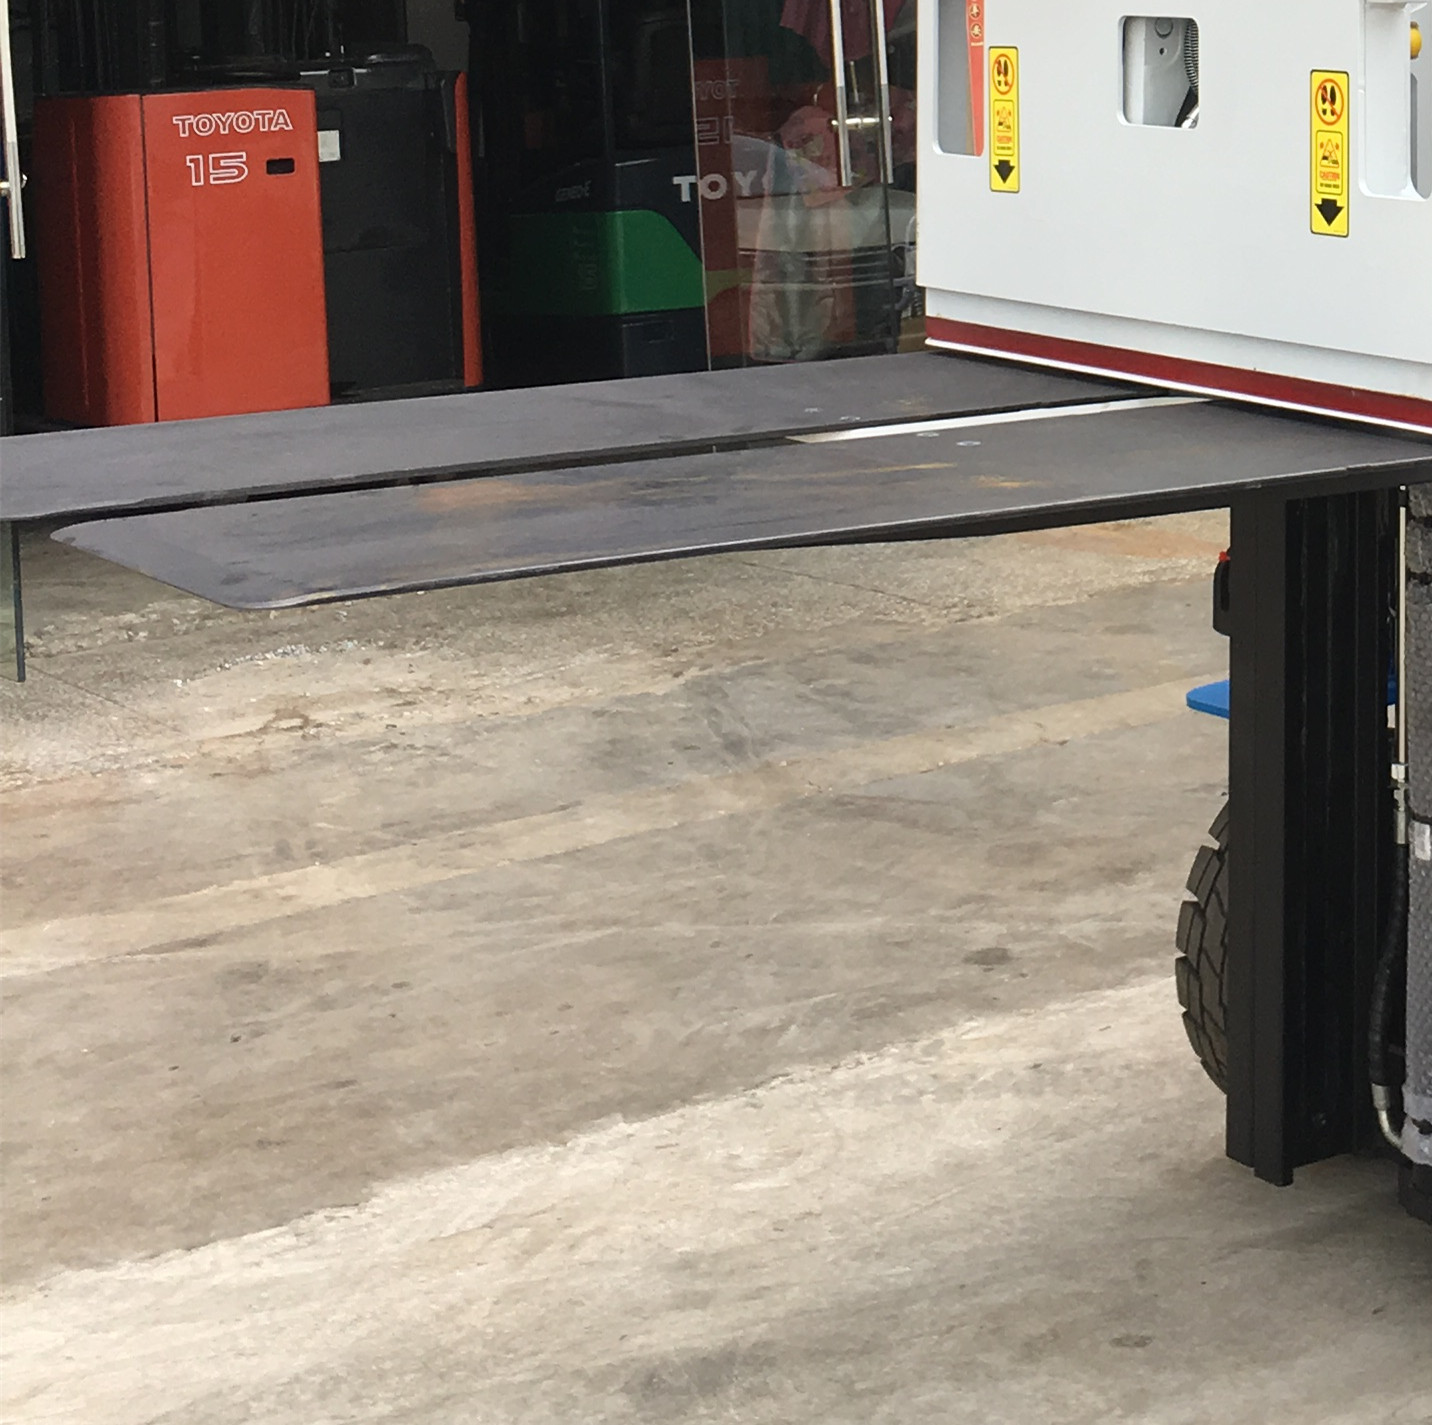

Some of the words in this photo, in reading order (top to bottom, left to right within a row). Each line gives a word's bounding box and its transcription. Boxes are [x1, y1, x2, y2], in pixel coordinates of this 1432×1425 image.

[172, 109, 293, 137] TOYOTA
[186, 151, 248, 186] 15
[672, 170, 759, 202] TOY
